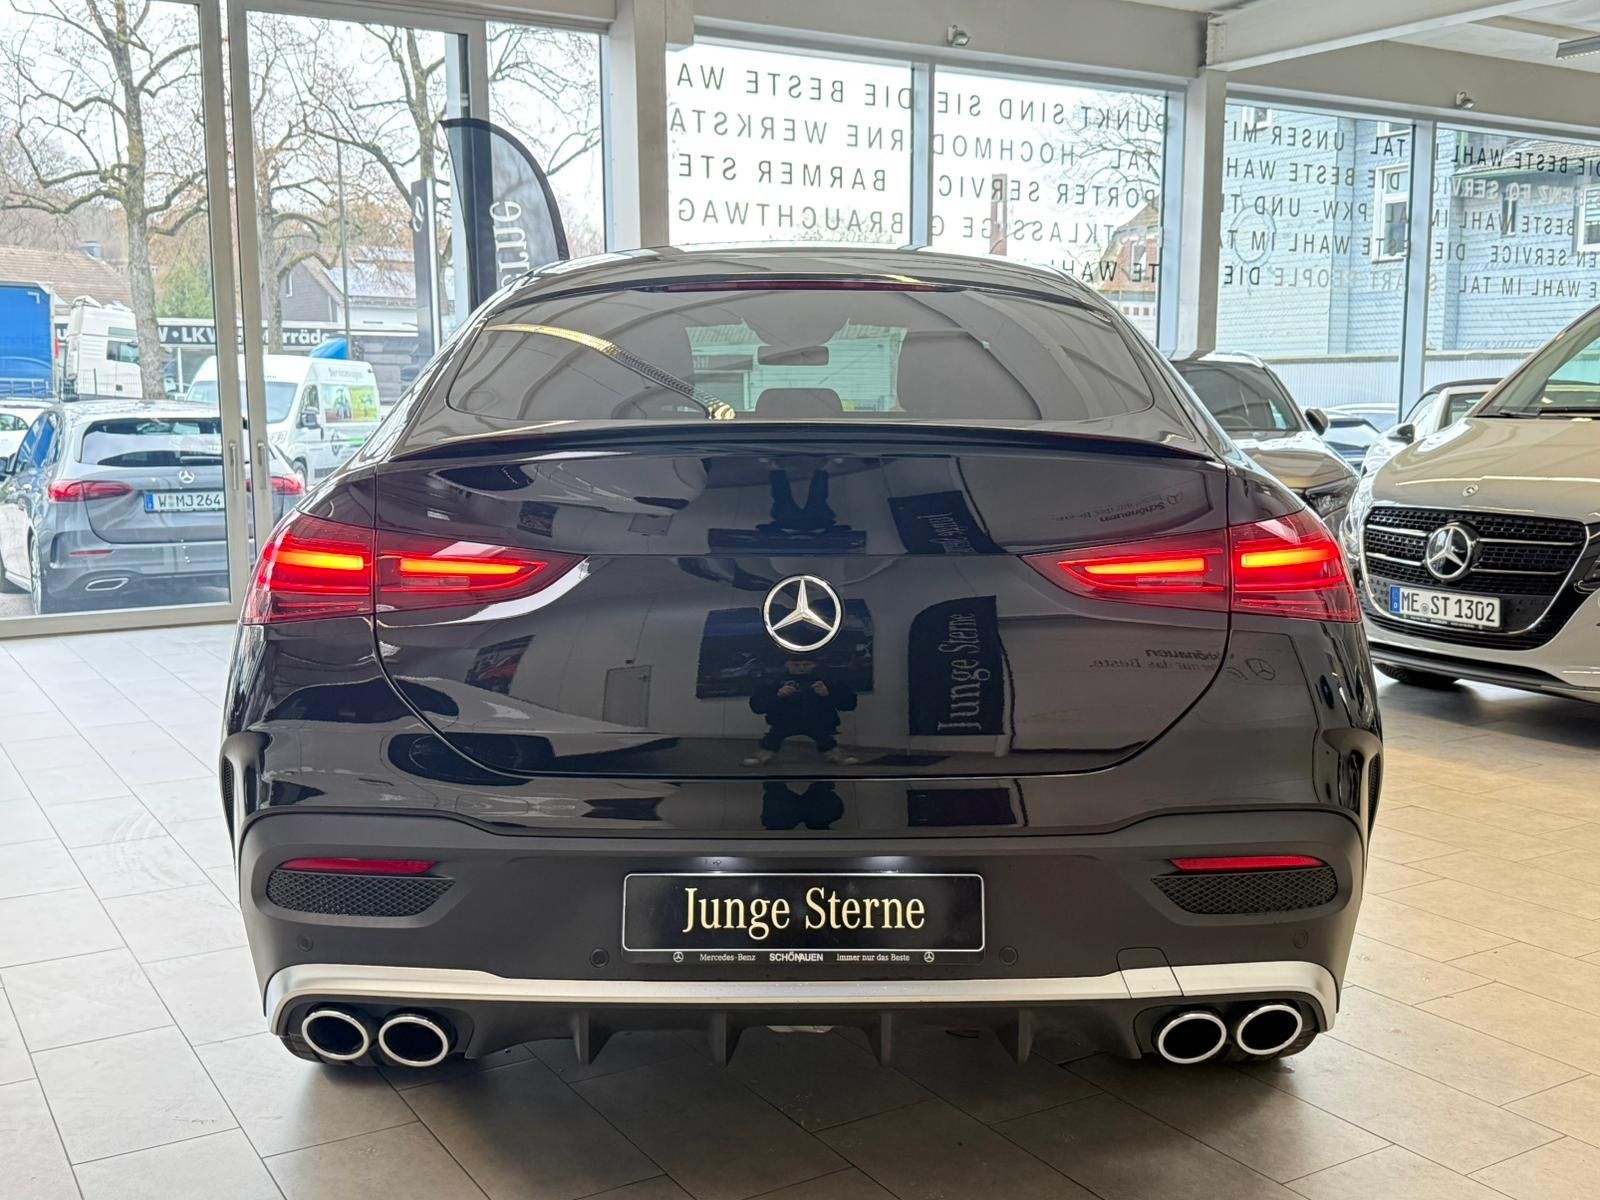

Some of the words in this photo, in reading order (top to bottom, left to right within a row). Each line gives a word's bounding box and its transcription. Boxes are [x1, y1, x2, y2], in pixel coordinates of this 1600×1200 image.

[158, 495, 166, 507] W
[1401, 590, 1420, 613] ME
[1430, 595, 1450, 617] ST
[1454, 598, 1496, 623] 1302
[937, 657, 991, 732] Junge
[682, 887, 790, 941] Junge
[804, 886, 926, 930] Sterne
[769, 951, 824, 962] SCHÖNAUEN
[836, 953, 860, 962] Immer
[862, 954, 875, 962] nur
[876, 953, 889, 962] das
[890, 953, 910, 962] Beste
